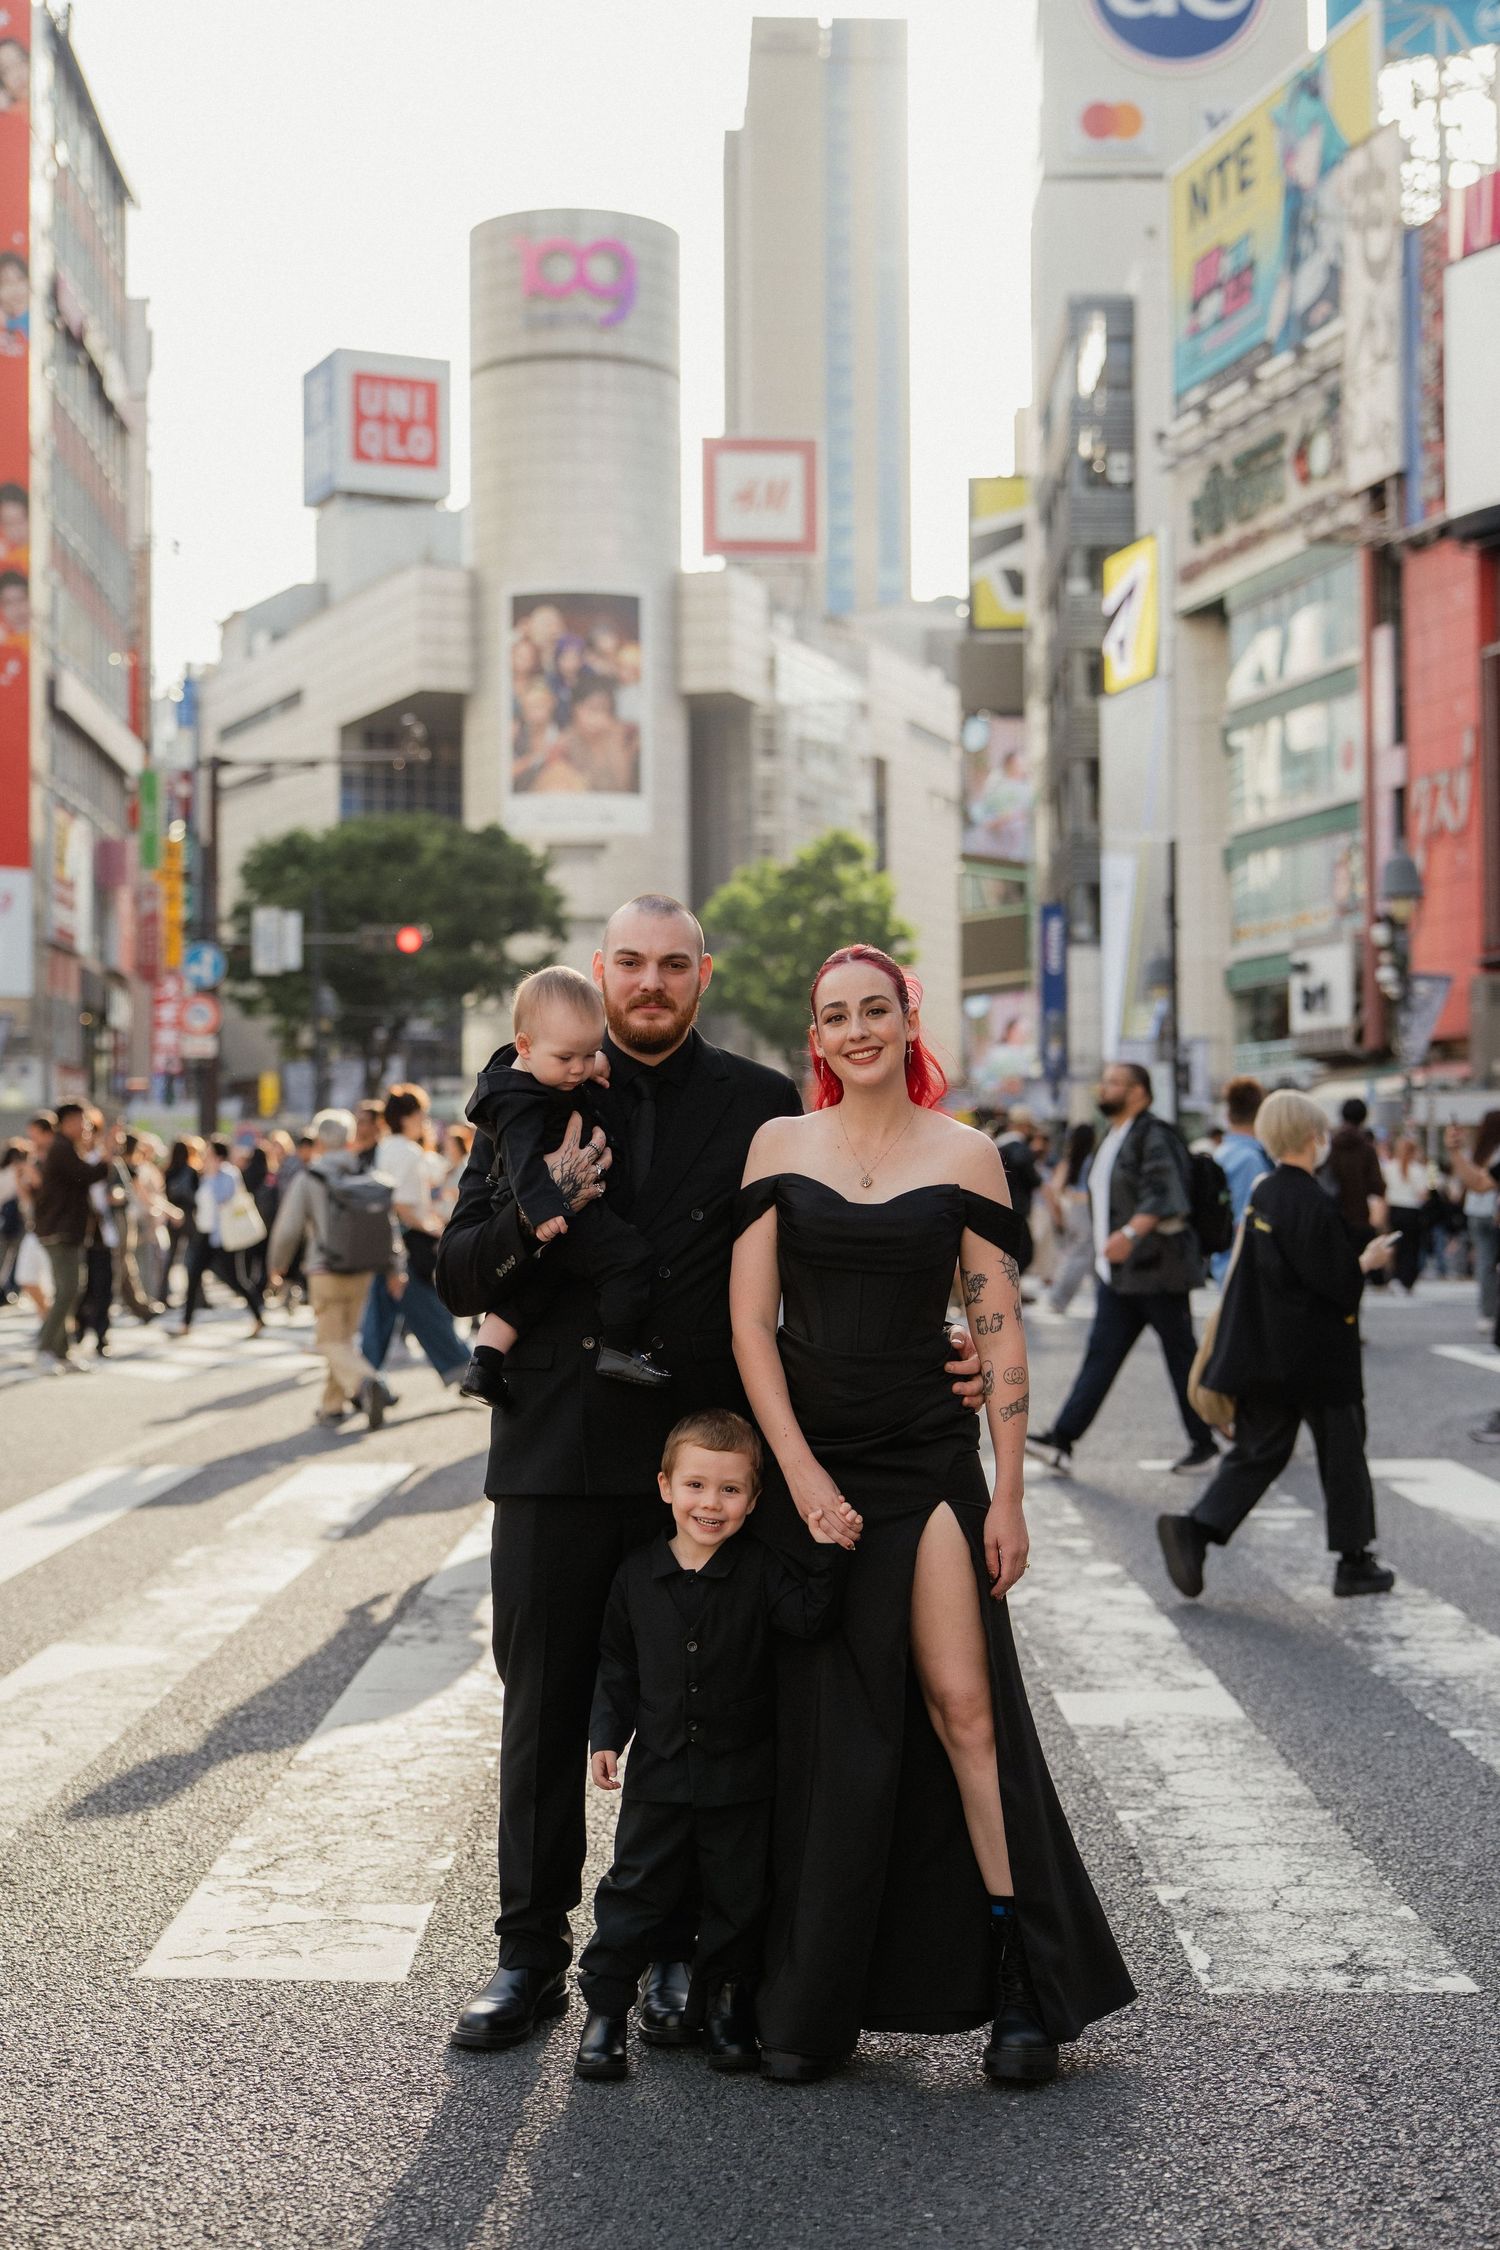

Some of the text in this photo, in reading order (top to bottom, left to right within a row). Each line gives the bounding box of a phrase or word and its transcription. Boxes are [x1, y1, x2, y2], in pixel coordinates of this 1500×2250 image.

[511, 235, 639, 329] 109
[358, 380, 428, 422] UNI
[358, 421, 434, 462] QLO
